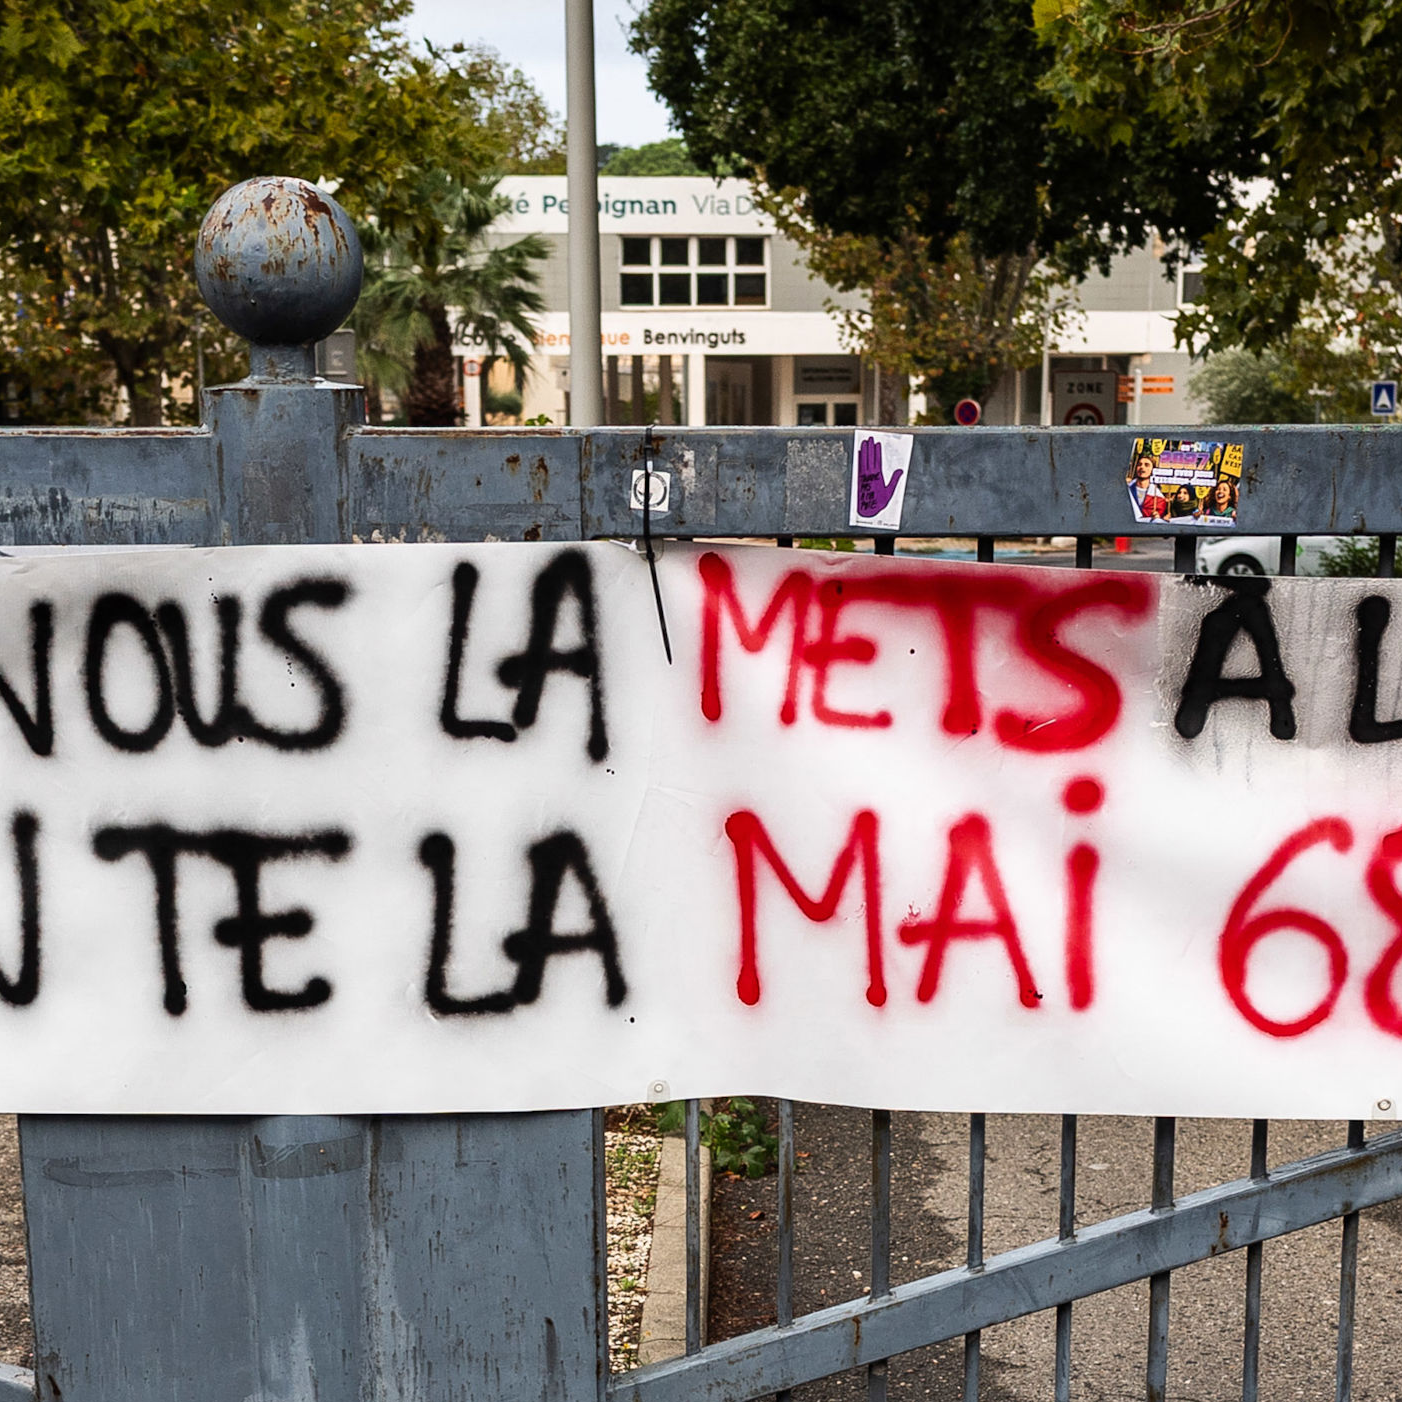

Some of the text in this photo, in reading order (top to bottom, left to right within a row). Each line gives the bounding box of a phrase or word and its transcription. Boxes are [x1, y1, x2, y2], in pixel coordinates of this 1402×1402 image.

[692, 193, 730, 216] Via
[643, 327, 747, 350] Benvinguts
[1066, 381, 1104, 394] ZONE
[438, 549, 610, 763] LA
[699, 551, 1156, 754] METS
[93, 823, 353, 1016] TE
[420, 828, 629, 1016] LA
